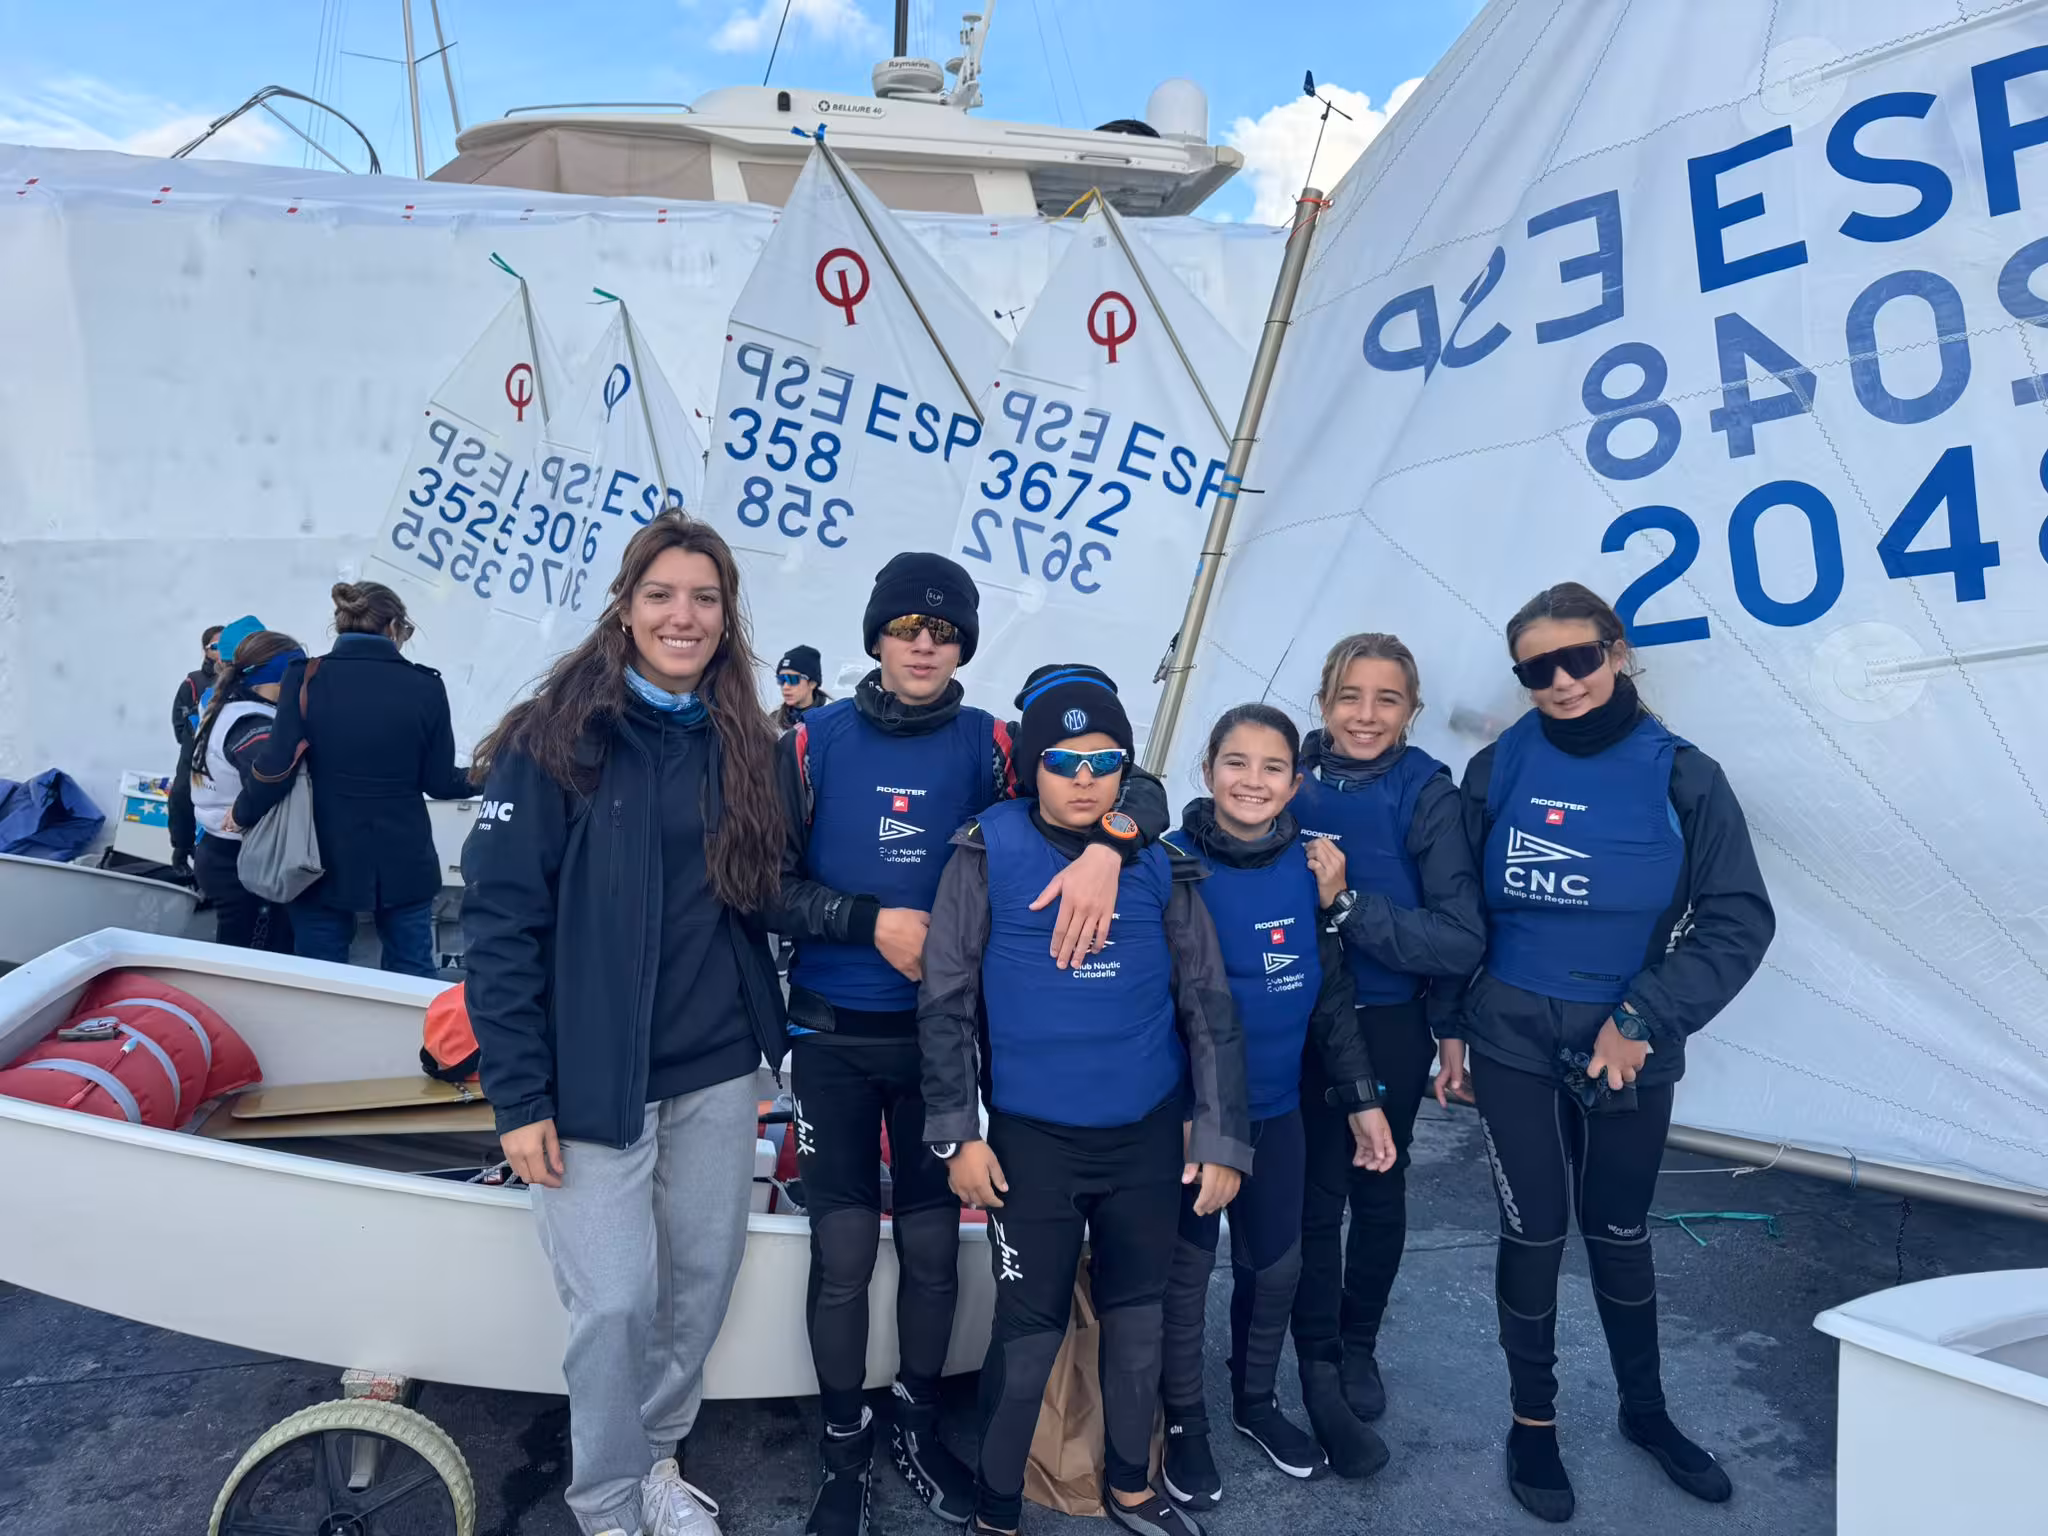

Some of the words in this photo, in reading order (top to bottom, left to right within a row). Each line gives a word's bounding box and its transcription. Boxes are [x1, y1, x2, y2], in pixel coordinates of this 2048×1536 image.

[888, 61, 930, 69] Raymarine
[832, 103, 871, 114] BELLIURE
[1687, 44, 2048, 293] ESP
[725, 407, 842, 484] 358
[864, 383, 984, 463] ESP
[409, 467, 517, 555] 3525
[980, 449, 1131, 538] 3672
[1600, 445, 2048, 648] 204
[876, 786, 927, 796] ROOSTER
[1530, 797, 1588, 812] ROOSTER
[1504, 887, 1527, 899] Equip
[1529, 893, 1542, 901] de
[1544, 894, 1589, 906] Regates
[1505, 866, 1590, 896] CNC
[1255, 917, 1295, 930] ROOSTER
[1072, 970, 1116, 978] Ciutadella
[793, 1093, 816, 1155] Zhik
[991, 1214, 1023, 1281] Zhik
